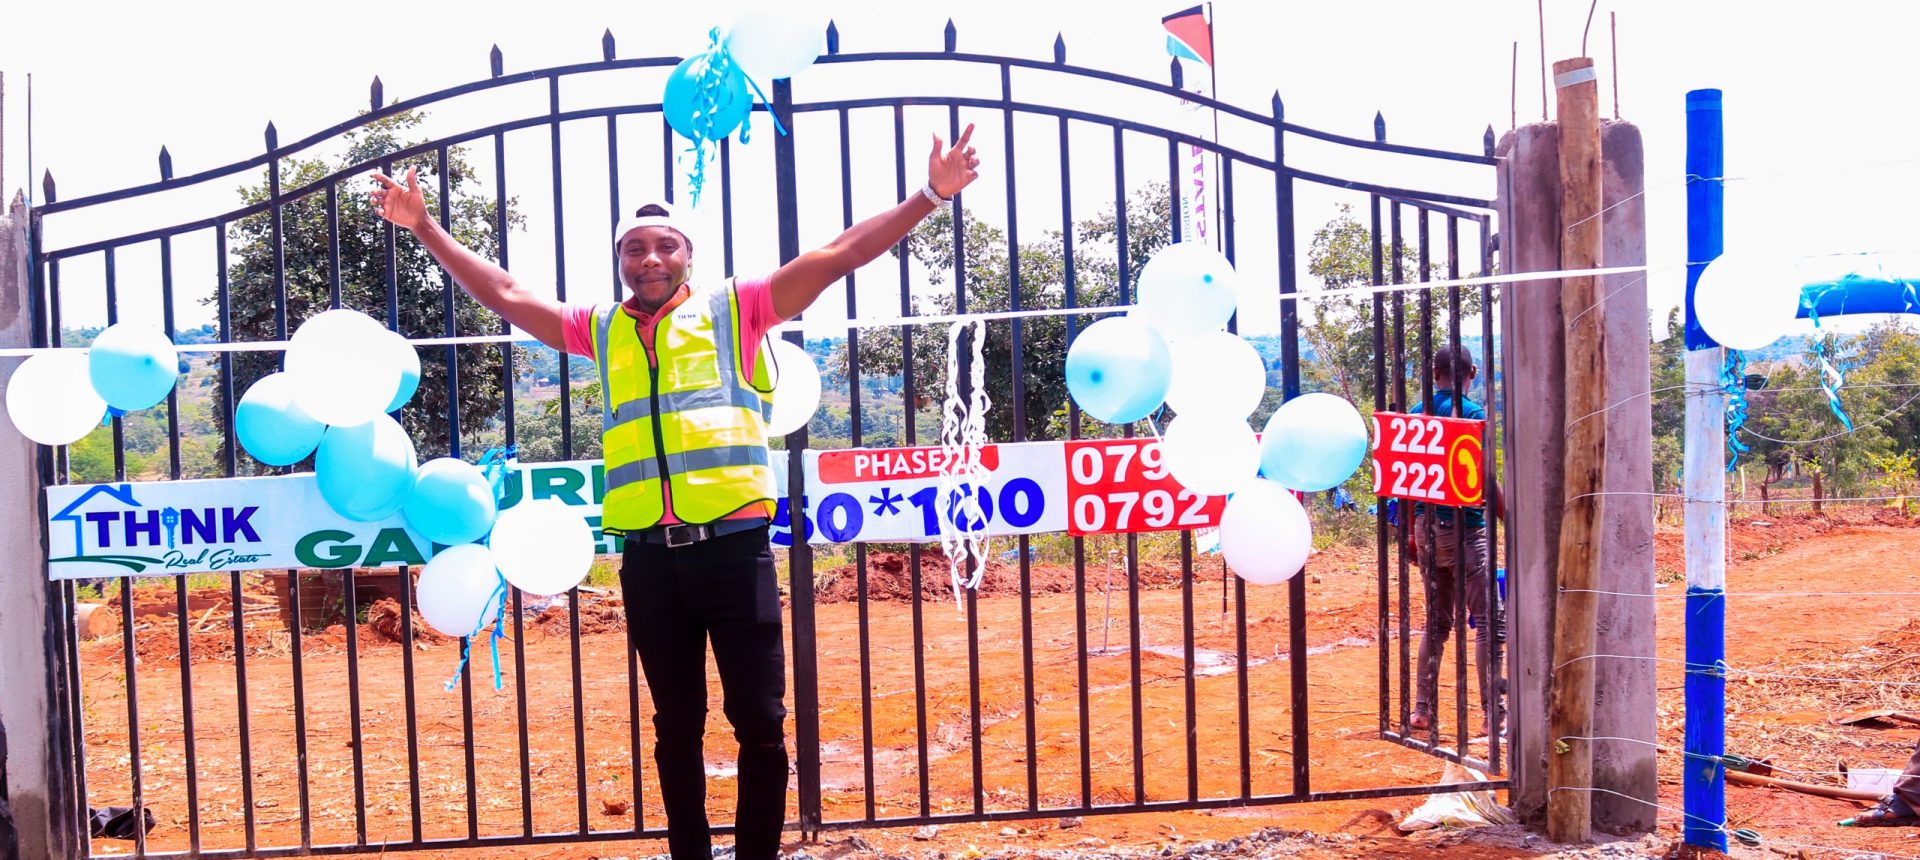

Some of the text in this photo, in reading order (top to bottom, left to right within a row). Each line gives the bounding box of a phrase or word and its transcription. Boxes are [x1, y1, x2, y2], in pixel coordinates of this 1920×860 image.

[1390, 417, 1445, 455] 222
[855, 451, 941, 477] PHASE
[1071, 443, 1171, 486] 079
[1391, 460, 1446, 500] 222
[86, 506, 262, 549] THINK
[1073, 489, 1210, 532] 0792
[163, 548, 272, 570] Real Estate
